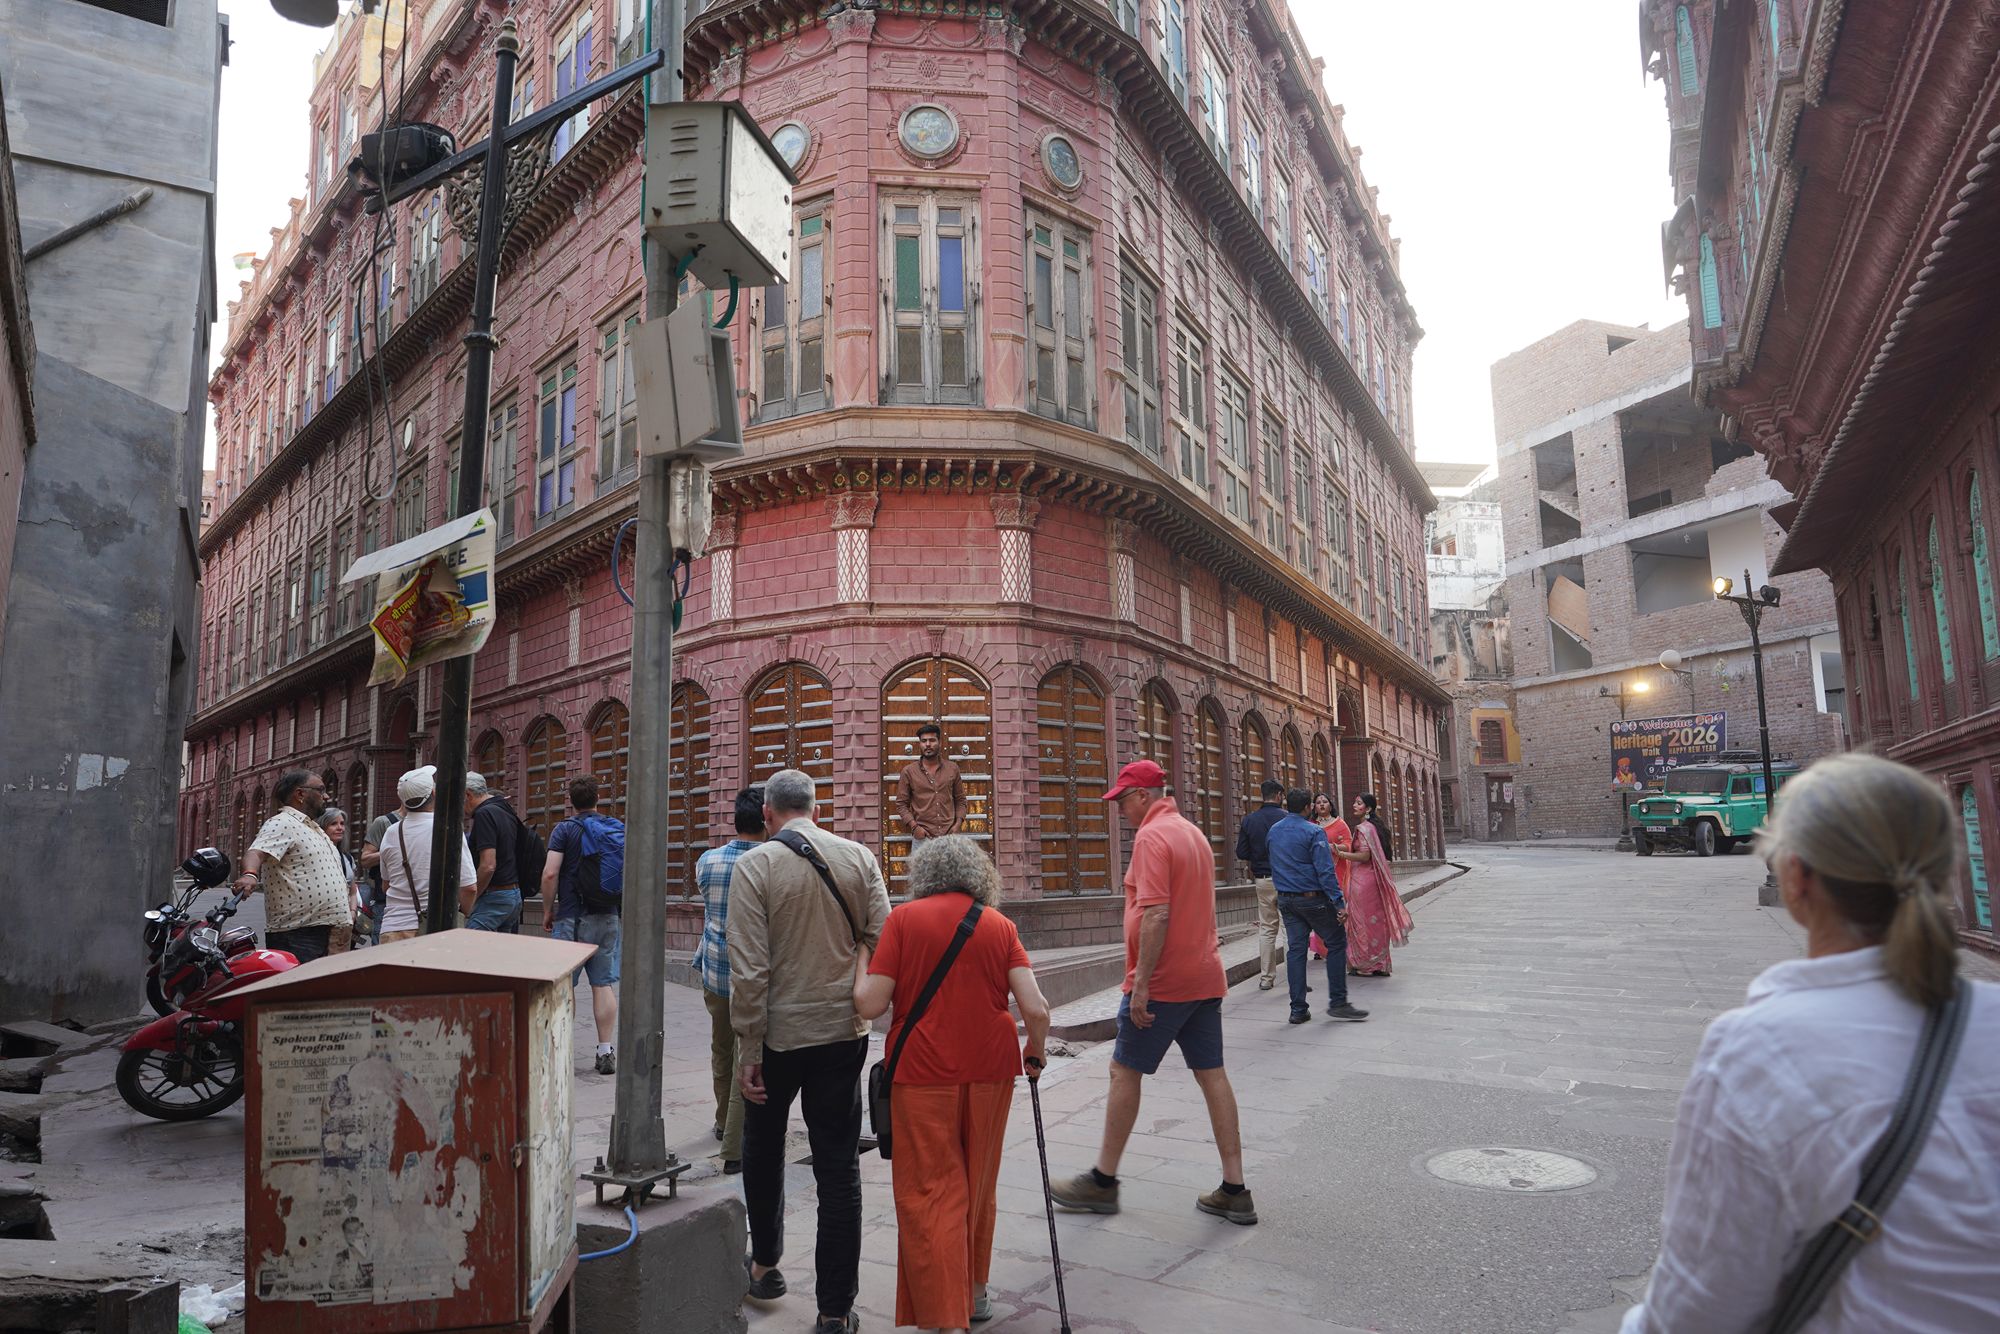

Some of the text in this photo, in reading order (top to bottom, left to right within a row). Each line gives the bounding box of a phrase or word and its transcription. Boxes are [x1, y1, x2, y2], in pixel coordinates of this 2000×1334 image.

[1639, 719, 1693, 730] Welcome
[1613, 732, 1662, 750] Heritage
[1668, 725, 1719, 747] 2026
[1641, 747, 1661, 757] Walk
[1668, 744, 1717, 755] HAPPY NEW YEAR
[1648, 766, 1655, 774] 9
[1661, 765, 1671, 773] 10
[272, 1034, 316, 1046] Spoken
[318, 1031, 363, 1043] English
[291, 1044, 345, 1055] Program
